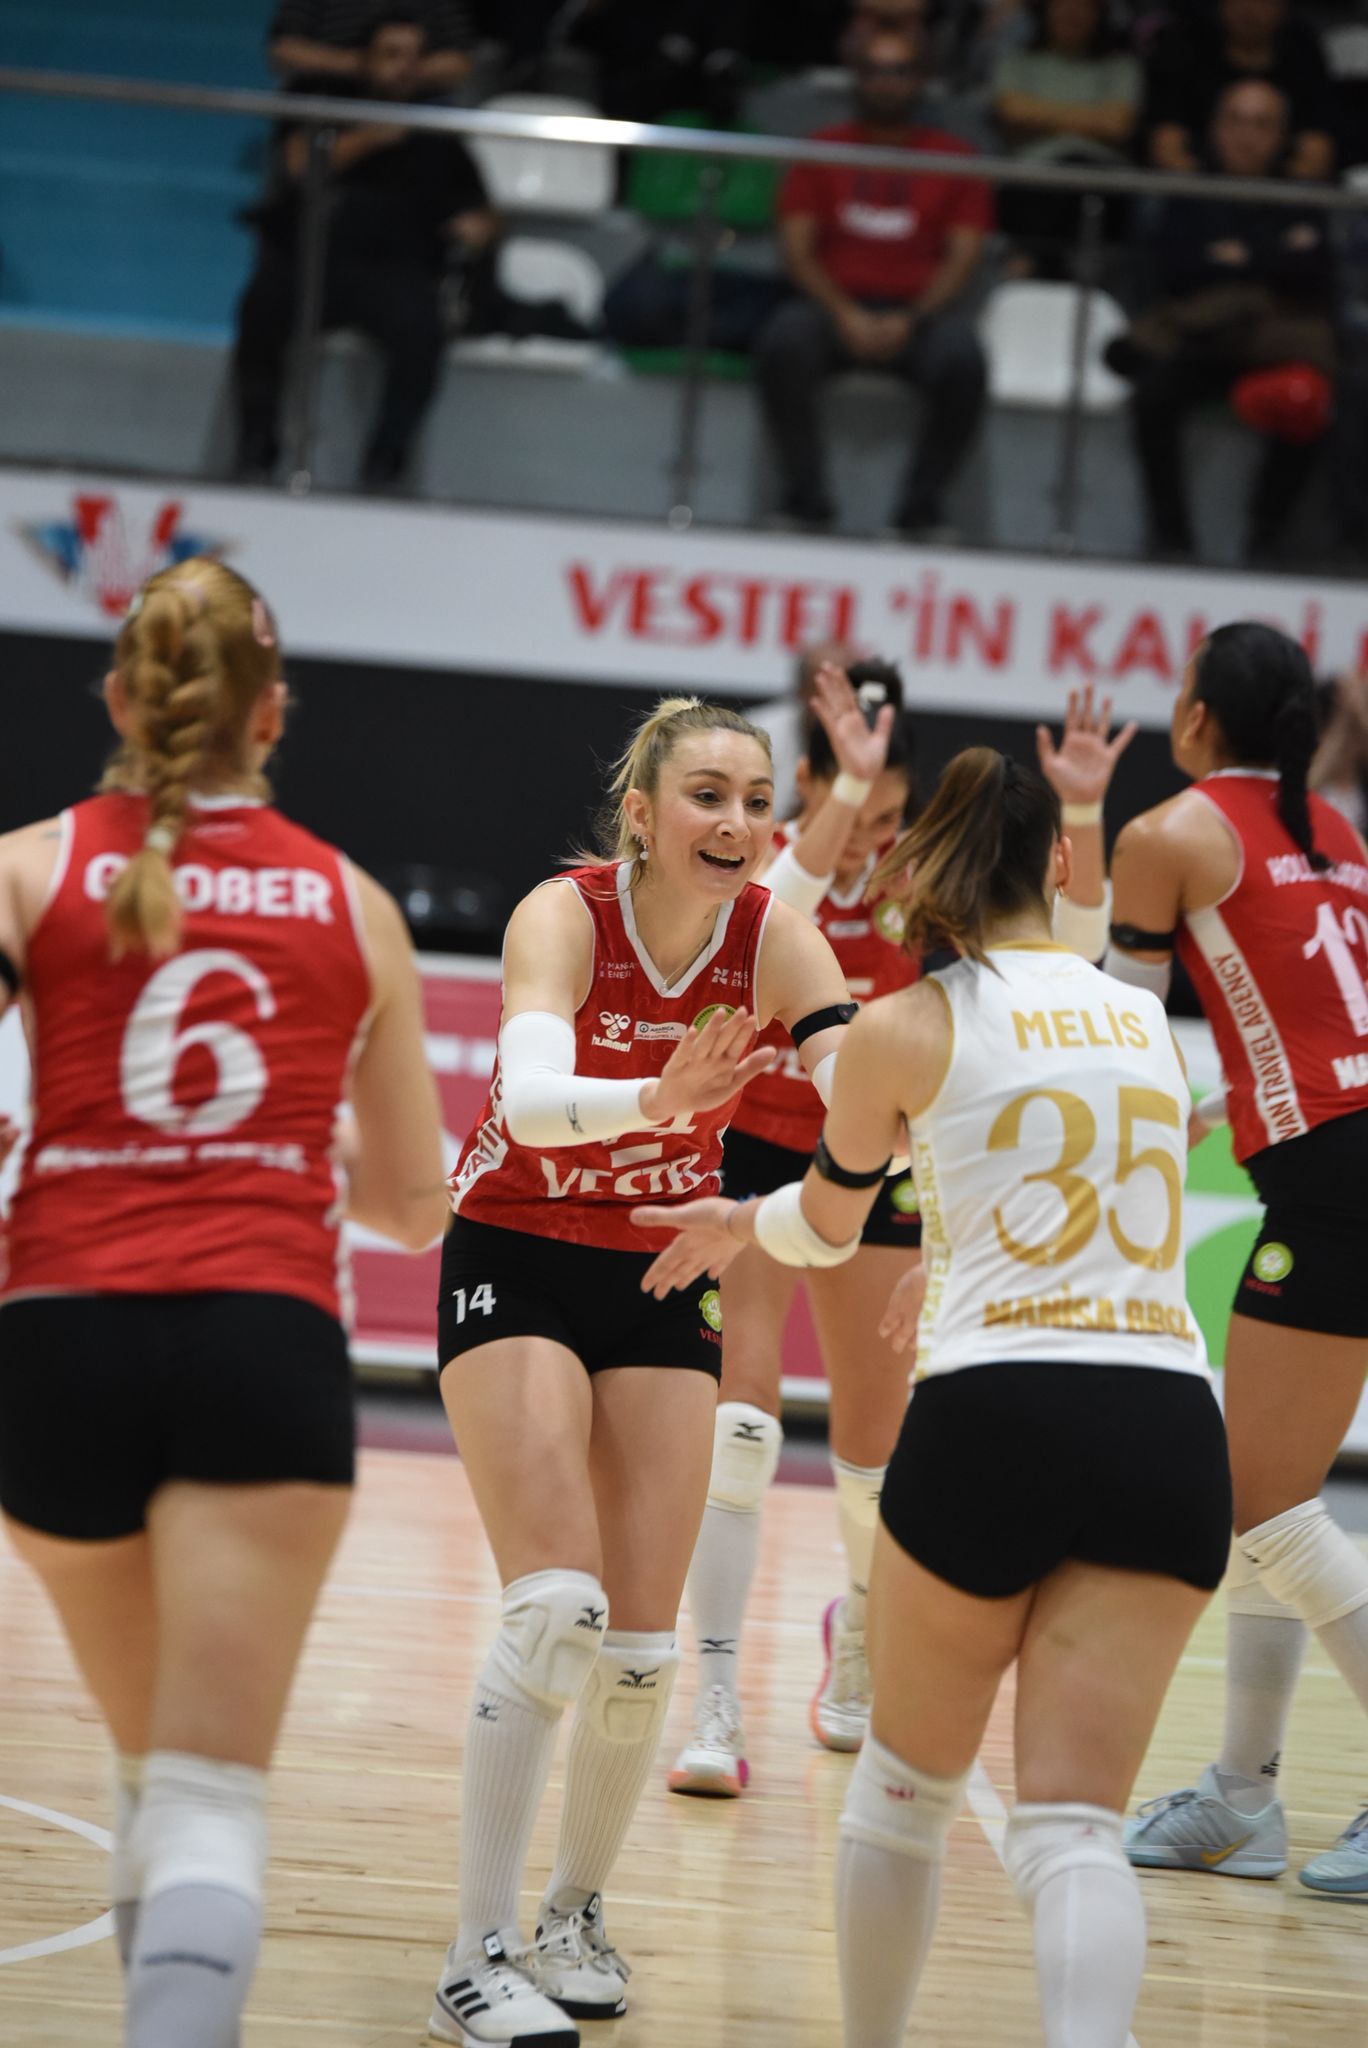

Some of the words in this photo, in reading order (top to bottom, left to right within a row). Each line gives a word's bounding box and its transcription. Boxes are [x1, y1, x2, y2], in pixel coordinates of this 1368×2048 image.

[564, 560, 876, 660] VESTEL
[1046, 598, 1323, 684] KAİ
[83, 853, 335, 924] GOBER
[1212, 952, 1265, 1028] AGENCY
[119, 947, 278, 1138] 6
[1010, 1002, 1150, 1051] MELİS
[1250, 1030, 1287, 1102] TRAVEL
[1268, 1099, 1300, 1140] VAN
[985, 1086, 1183, 1274] 35
[452, 1283, 496, 1325] 14
